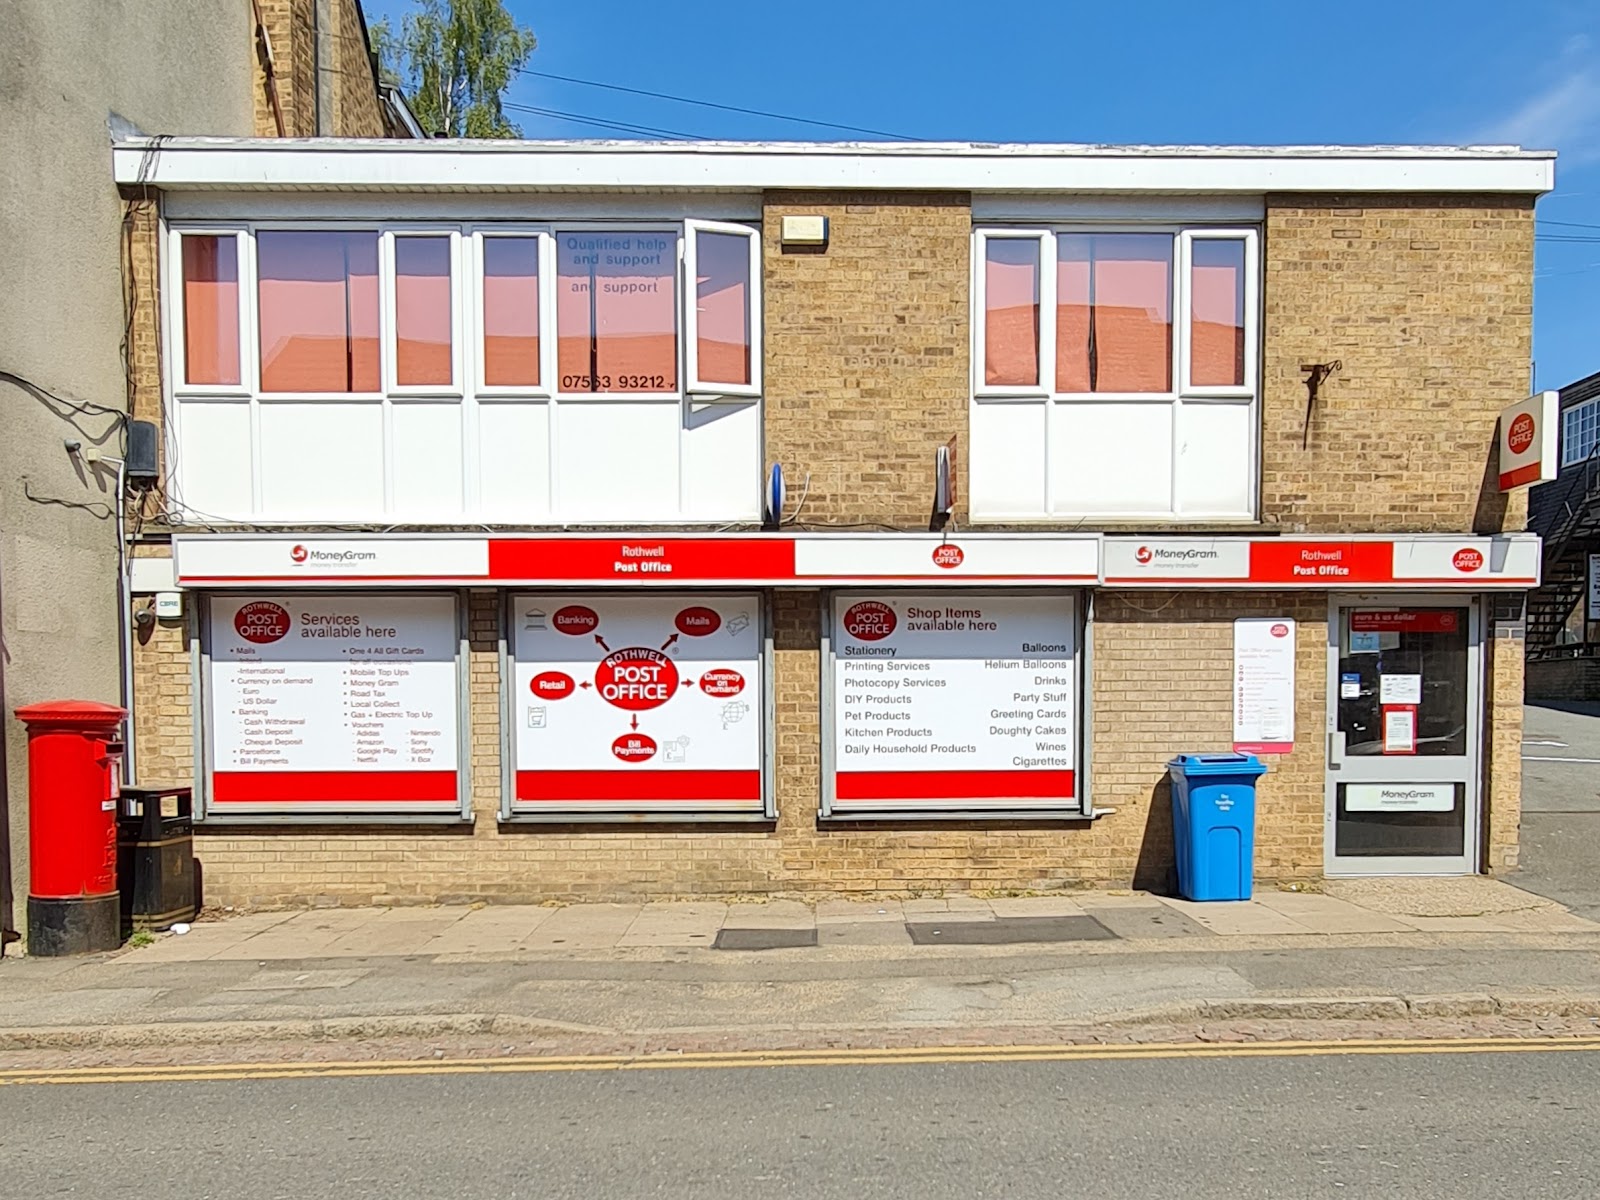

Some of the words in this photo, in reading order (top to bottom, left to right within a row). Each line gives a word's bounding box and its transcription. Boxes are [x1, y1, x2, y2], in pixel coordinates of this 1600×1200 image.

[567, 238, 630, 250] Qualified
[637, 238, 666, 251] help
[573, 254, 599, 265] and
[606, 254, 661, 267] support
[571, 282, 595, 292] an
[604, 282, 658, 294] support
[1514, 420, 1530, 434] POST
[1510, 430, 1532, 447] OFFICE
[310, 550, 376, 562] MoneyGram
[622, 545, 665, 557] Rothwell
[938, 549, 959, 557] POST
[1155, 549, 1217, 561] MoneyGram
[1301, 550, 1342, 561] Rothwell
[1458, 552, 1479, 561] POST
[935, 556, 961, 564] OFFICE
[1455, 560, 1481, 568] OFFICE
[614, 561, 639, 572] Post
[641, 561, 672, 572] Office
[1293, 565, 1316, 576] Post
[1319, 565, 1349, 576] Office
[242, 603, 283, 615] ROTHWELL
[851, 602, 890, 614] ROTHWELL
[247, 614, 278, 625] POST
[301, 613, 360, 625] Services
[856, 613, 884, 623] POST
[907, 607, 943, 621] Shop
[946, 607, 981, 619] Items
[557, 616, 594, 627] Banking
[686, 616, 710, 626] Mails
[907, 619, 965, 631] available
[969, 619, 997, 631] here
[240, 625, 283, 637] OFFICE
[301, 626, 361, 638] available
[366, 626, 396, 638] here
[850, 624, 890, 634] OFFICE
[845, 646, 897, 657] Stationery
[1022, 643, 1066, 653] Balloons
[606, 649, 668, 669] ROTHWELL
[985, 660, 1020, 669] Helium
[1023, 660, 1066, 669] Balloons
[378, 669, 392, 677] Top
[394, 669, 409, 677] Ups
[845, 662, 884, 673] Printing
[887, 662, 930, 671] Services
[614, 666, 661, 682] POST
[704, 673, 741, 682] Currency
[237, 677, 270, 685] Currency
[539, 681, 566, 690] Retail
[845, 678, 900, 689] Photocopy
[903, 678, 947, 687] Services
[1034, 676, 1066, 686] Drinks
[603, 684, 668, 700] OFFICE
[705, 685, 740, 693] Demand
[845, 695, 862, 704] DIY
[866, 695, 912, 704] Products
[1013, 692, 1040, 704] Party
[1043, 692, 1067, 702] Stuff
[406, 711, 420, 719] Top
[422, 711, 433, 719] Up
[845, 711, 862, 720] Pet
[865, 711, 911, 720] Products
[990, 709, 1034, 720] Greeting
[1036, 709, 1066, 718] Cards
[845, 728, 883, 737] Kitchen
[886, 728, 932, 737] Products
[989, 726, 1033, 737] Doughty
[1035, 726, 1067, 735] Cakes
[628, 740, 641, 748] Bill
[845, 744, 870, 755] Daily
[873, 744, 927, 753] Household
[930, 744, 976, 753] Products
[1035, 743, 1066, 752] Wines
[615, 746, 655, 756] Payments
[1012, 757, 1067, 768] Cigarettes
[1381, 790, 1435, 799] MoneyGram
